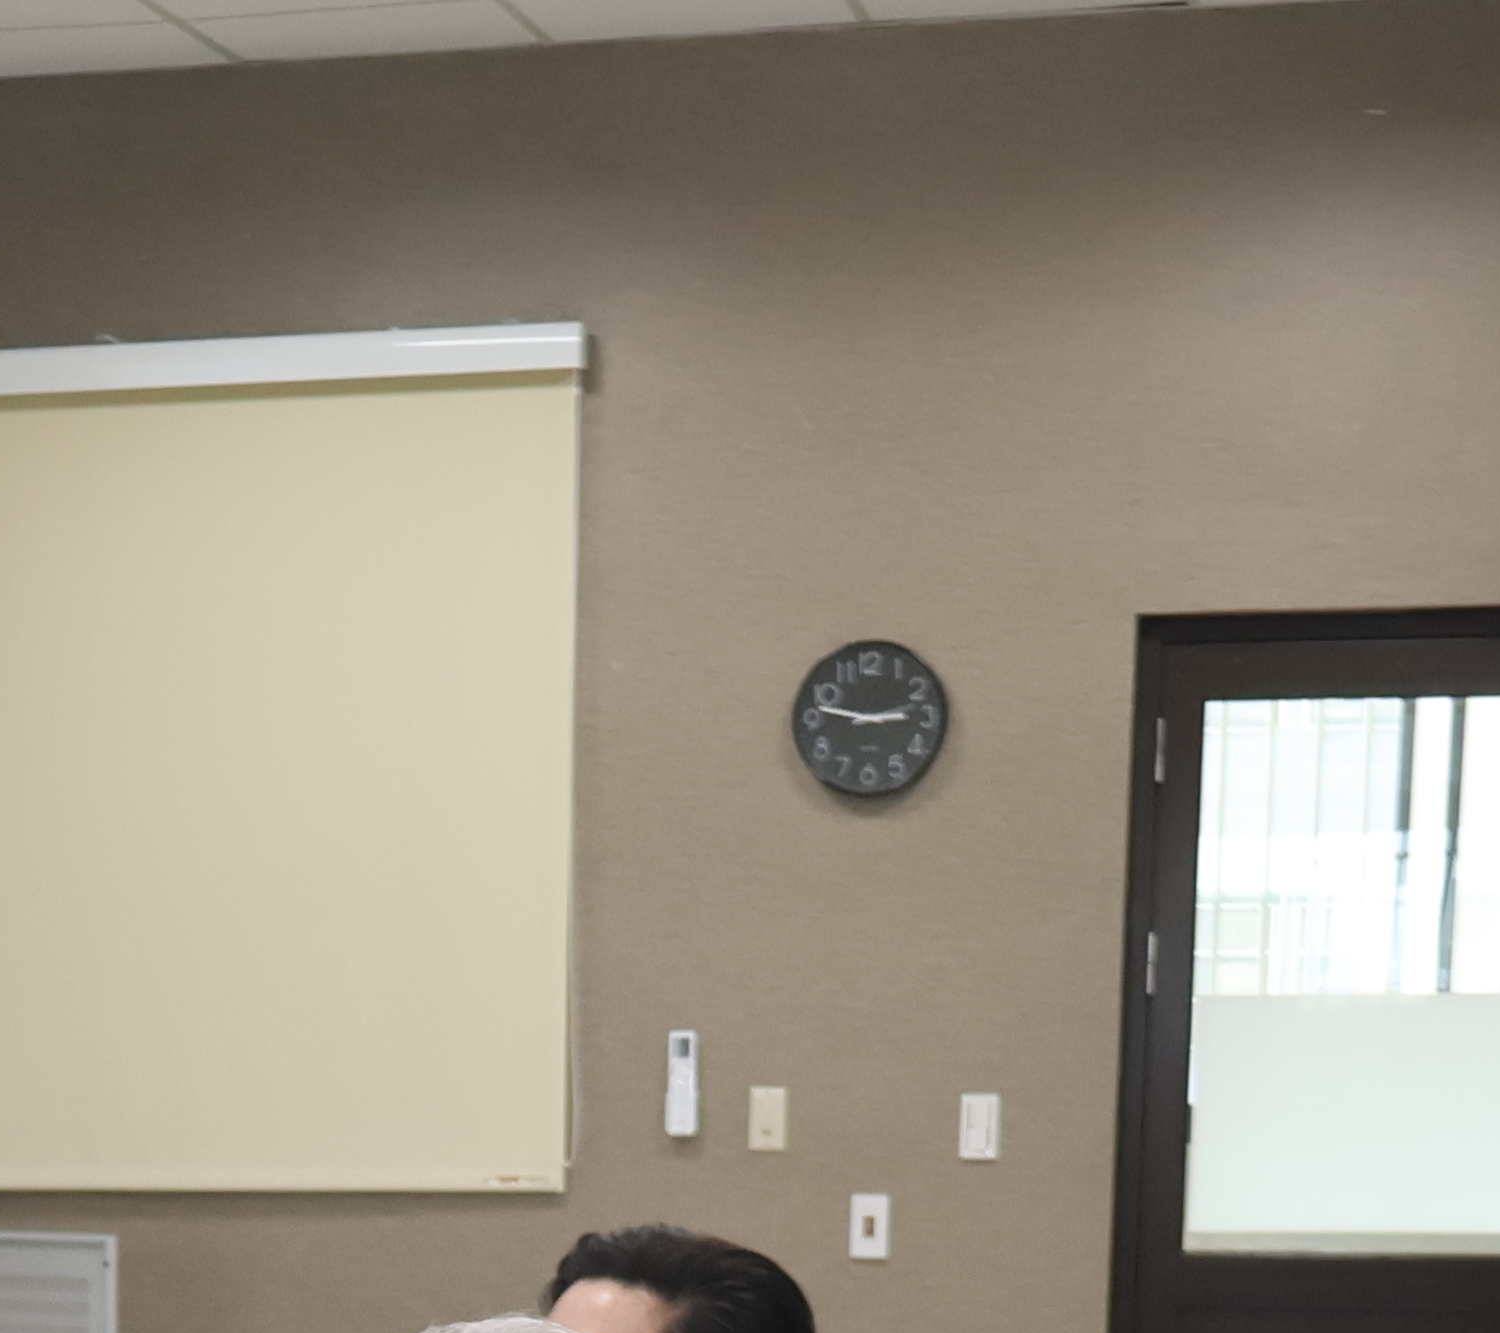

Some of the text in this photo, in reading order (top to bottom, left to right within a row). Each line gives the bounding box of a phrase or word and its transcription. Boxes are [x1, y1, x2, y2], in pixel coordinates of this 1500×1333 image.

[835, 660, 857, 683] 11
[858, 651, 882, 676] 12
[893, 658, 903, 680] 1
[814, 682, 840, 705] 10
[908, 676, 927, 701] 2
[802, 707, 821, 731] 9
[920, 704, 940, 729] 3
[813, 736, 829, 760] 8
[906, 733, 926, 755] 4
[835, 756, 850, 777] 7
[859, 762, 877, 786] 6
[888, 754, 904, 779] 5
